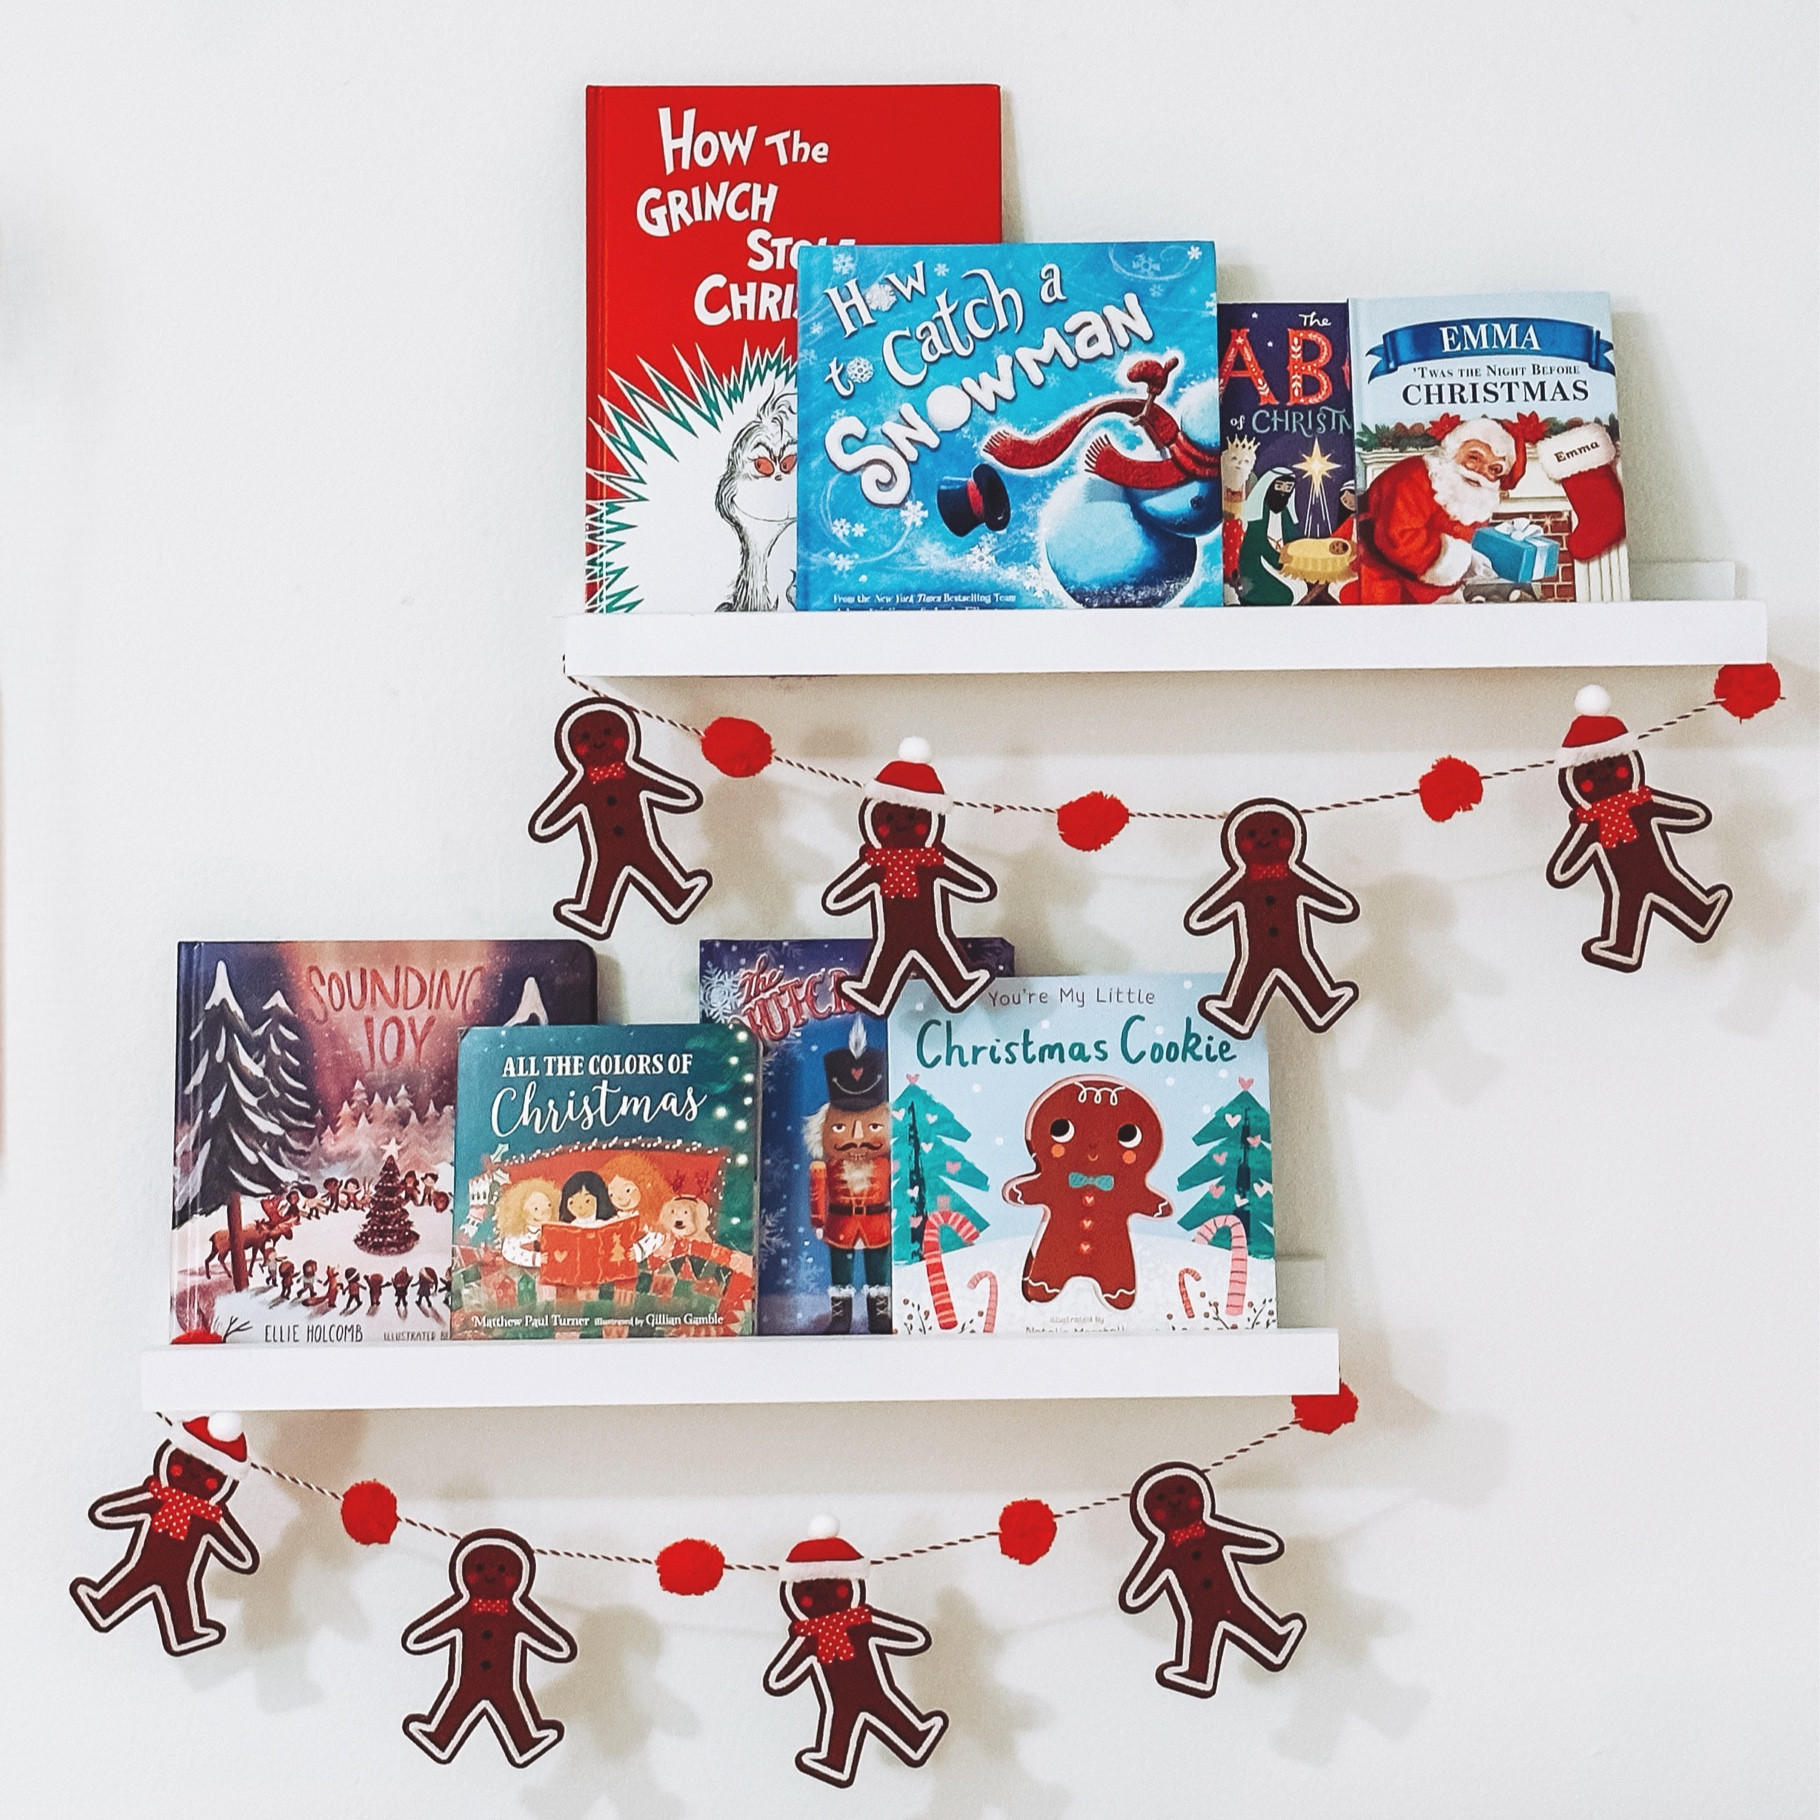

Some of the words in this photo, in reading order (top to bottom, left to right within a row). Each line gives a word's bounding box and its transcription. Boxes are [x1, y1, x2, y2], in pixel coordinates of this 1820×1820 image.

[764, 129, 830, 166] The
[636, 181, 779, 238] GRINCH
[693, 273, 798, 327] CHRI
[824, 356, 875, 397] to
[882, 268, 1040, 387] Catch
[1040, 263, 1067, 303] a
[1299, 311, 1332, 327] The
[1439, 323, 1542, 353] EMMA
[1219, 328, 1350, 406] AB
[1402, 379, 1590, 406] CHRISTMAS
[1230, 414, 1246, 431] of
[1553, 440, 1601, 464] Emma
[874, 593, 892, 603] New
[943, 592, 991, 604] Bestselling
[993, 593, 1016, 603] Team
[737, 953, 785, 1006] The
[307, 964, 486, 1025] SOUNDING
[987, 988, 1049, 1008] You're
[1059, 987, 1086, 1008] My
[1096, 987, 1156, 1005] Little
[364, 1014, 437, 1073] JOY
[916, 1018, 1109, 1070] Christmas
[1120, 1014, 1238, 1066] Cookie
[501, 1055, 541, 1078] ALL
[543, 1055, 584, 1076] THE
[588, 1053, 664, 1076] COLORS
[667, 1053, 693, 1075] OF
[491, 1079, 708, 1138] Christmas
[264, 1324, 300, 1343] ELLIE
[306, 1324, 364, 1343] HOLCOMB
[471, 1315, 523, 1328] Matthew
[524, 1314, 549, 1327] Paul
[551, 1314, 590, 1327] Turner
[635, 1316, 645, 1328] by
[645, 1313, 681, 1328] Gillian
[683, 1313, 724, 1326] Gamble
[1095, 1315, 1105, 1325] by
[383, 1331, 436, 1341] ILLUSTRATED
